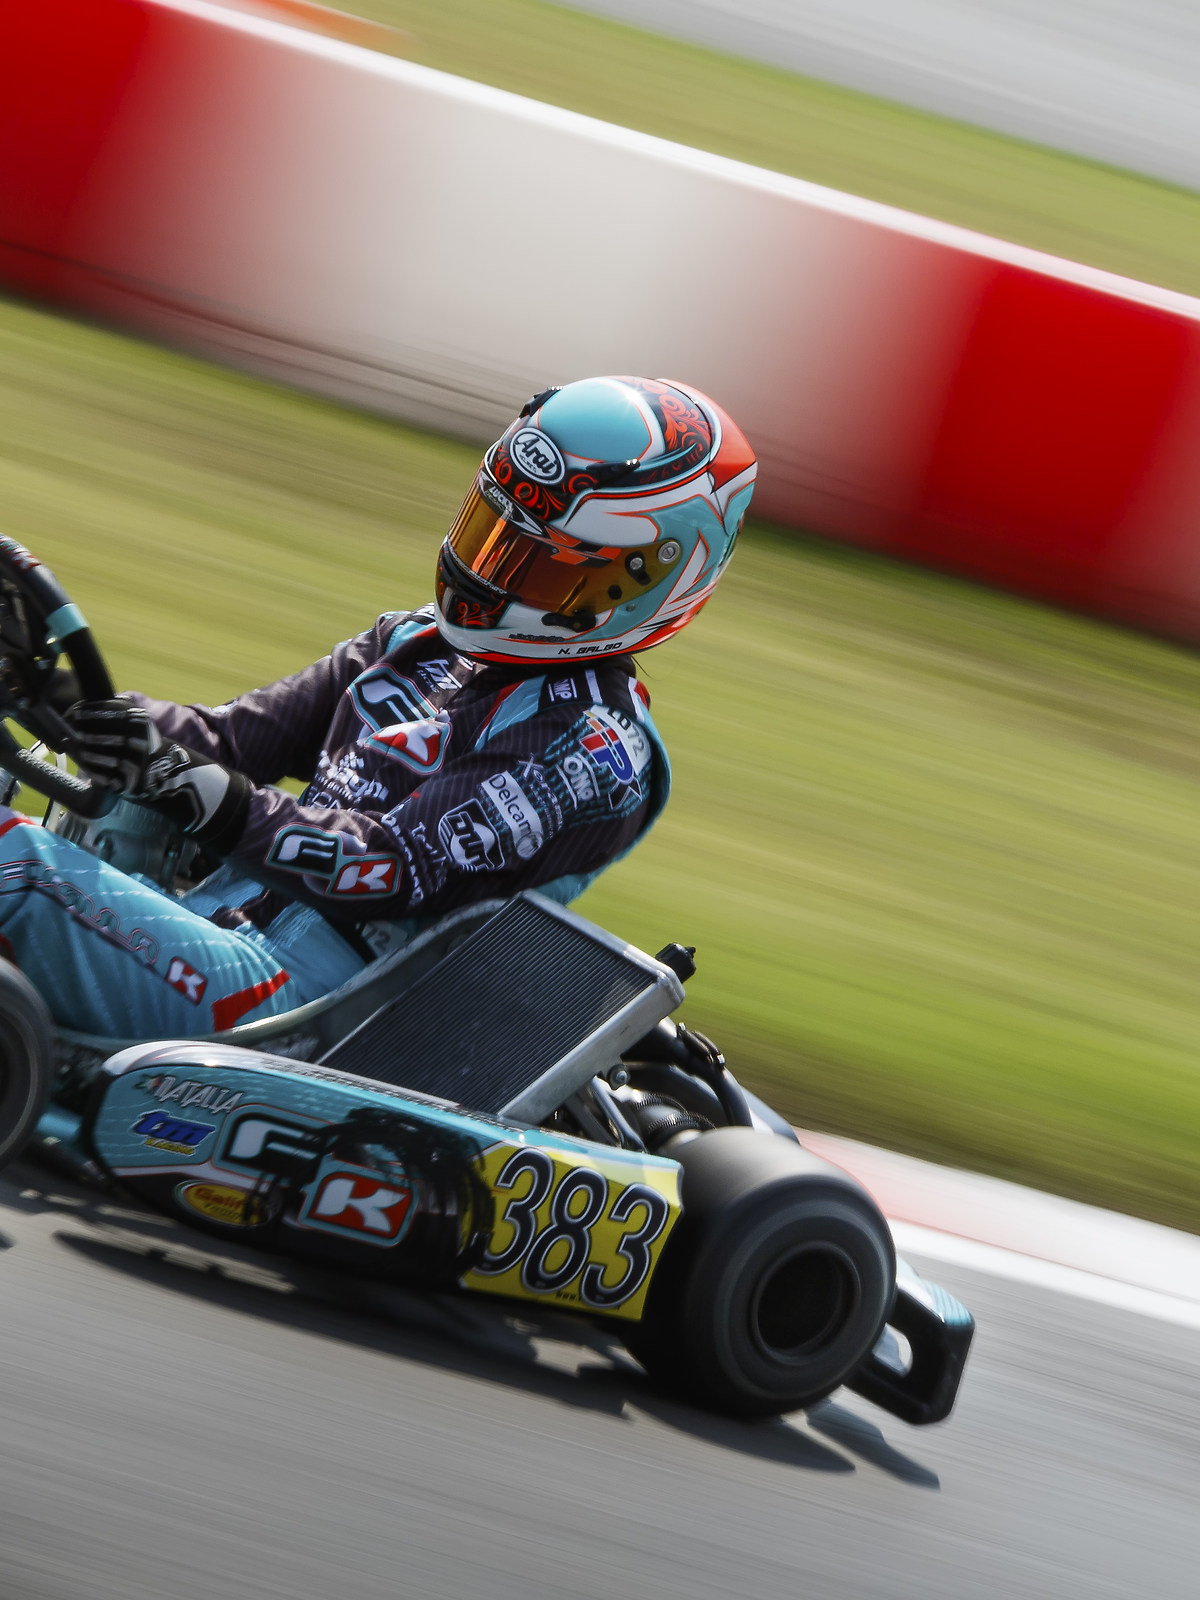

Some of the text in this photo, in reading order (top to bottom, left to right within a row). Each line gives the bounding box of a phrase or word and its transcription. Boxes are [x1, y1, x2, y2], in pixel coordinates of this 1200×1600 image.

[514, 437, 558, 473] Arai
[563, 756, 594, 800] OMP
[336, 863, 393, 891] K
[167, 959, 204, 1000] K
[153, 1075, 245, 1114] NATALIA
[316, 1178, 408, 1234] K
[472, 1146, 670, 1309] 383
